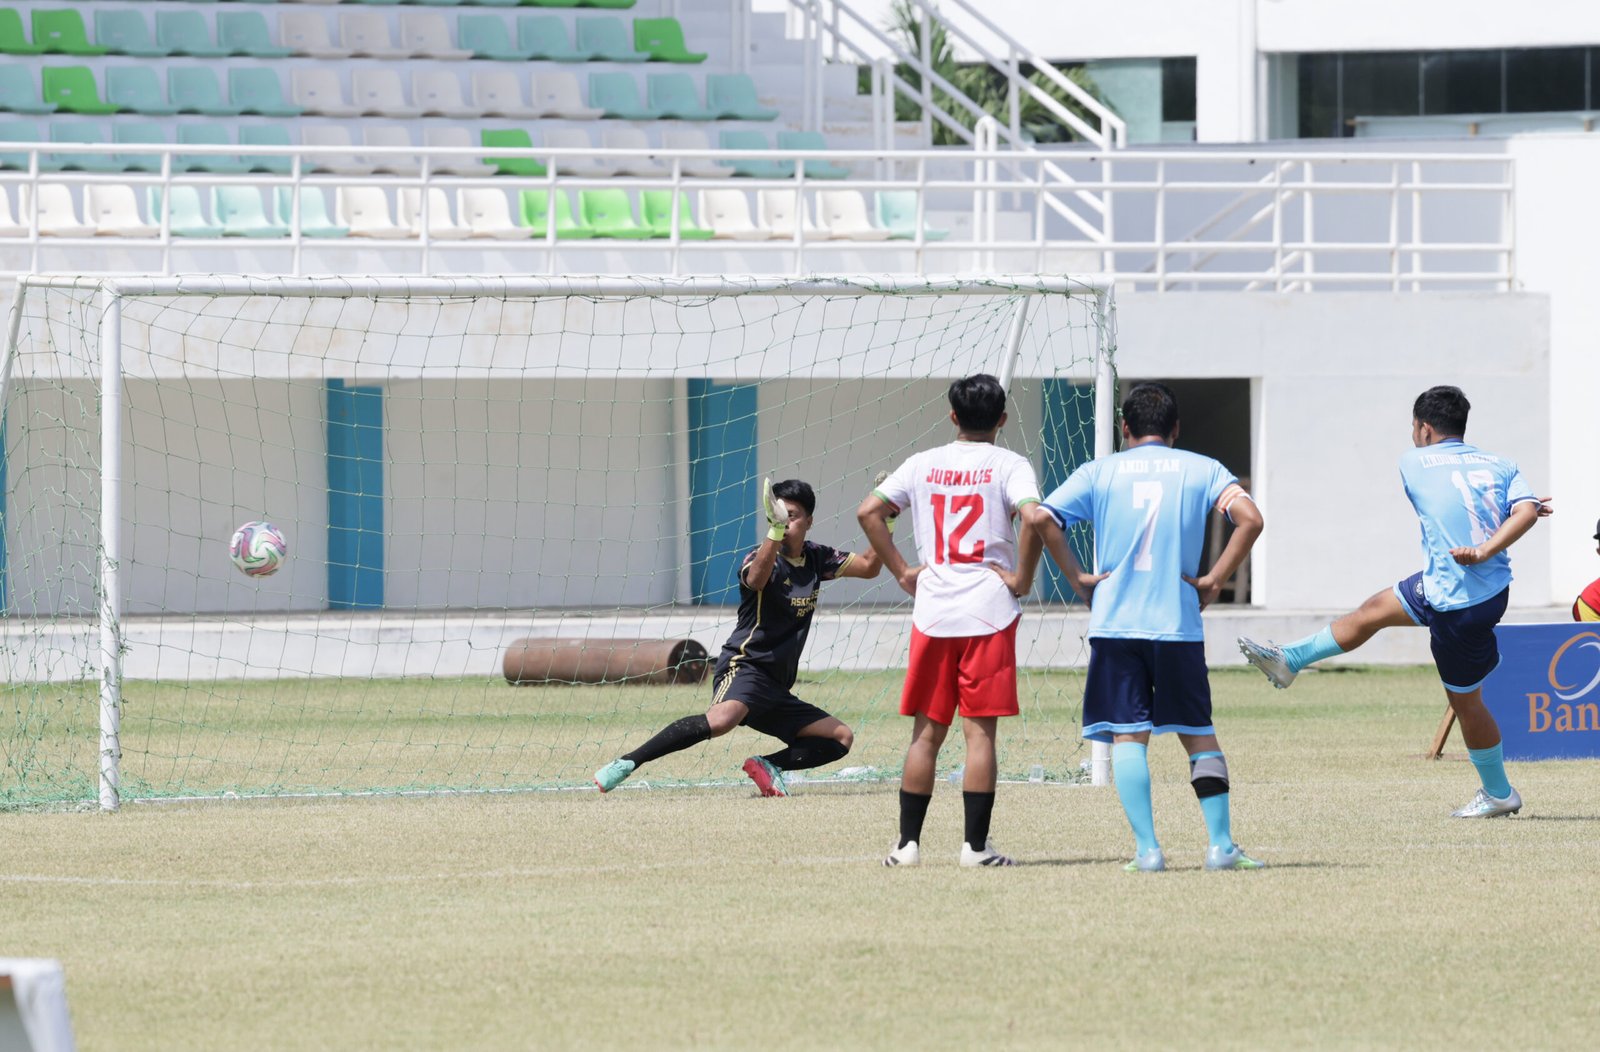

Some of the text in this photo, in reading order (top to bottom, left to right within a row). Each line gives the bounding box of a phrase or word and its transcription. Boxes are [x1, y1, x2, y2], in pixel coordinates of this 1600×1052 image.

[926, 467, 993, 486] JURNALIS
[1153, 458, 1180, 473] TAN
[930, 492, 985, 565] 12
[1132, 480, 1163, 571] 7
[1525, 692, 1600, 732] Ban
